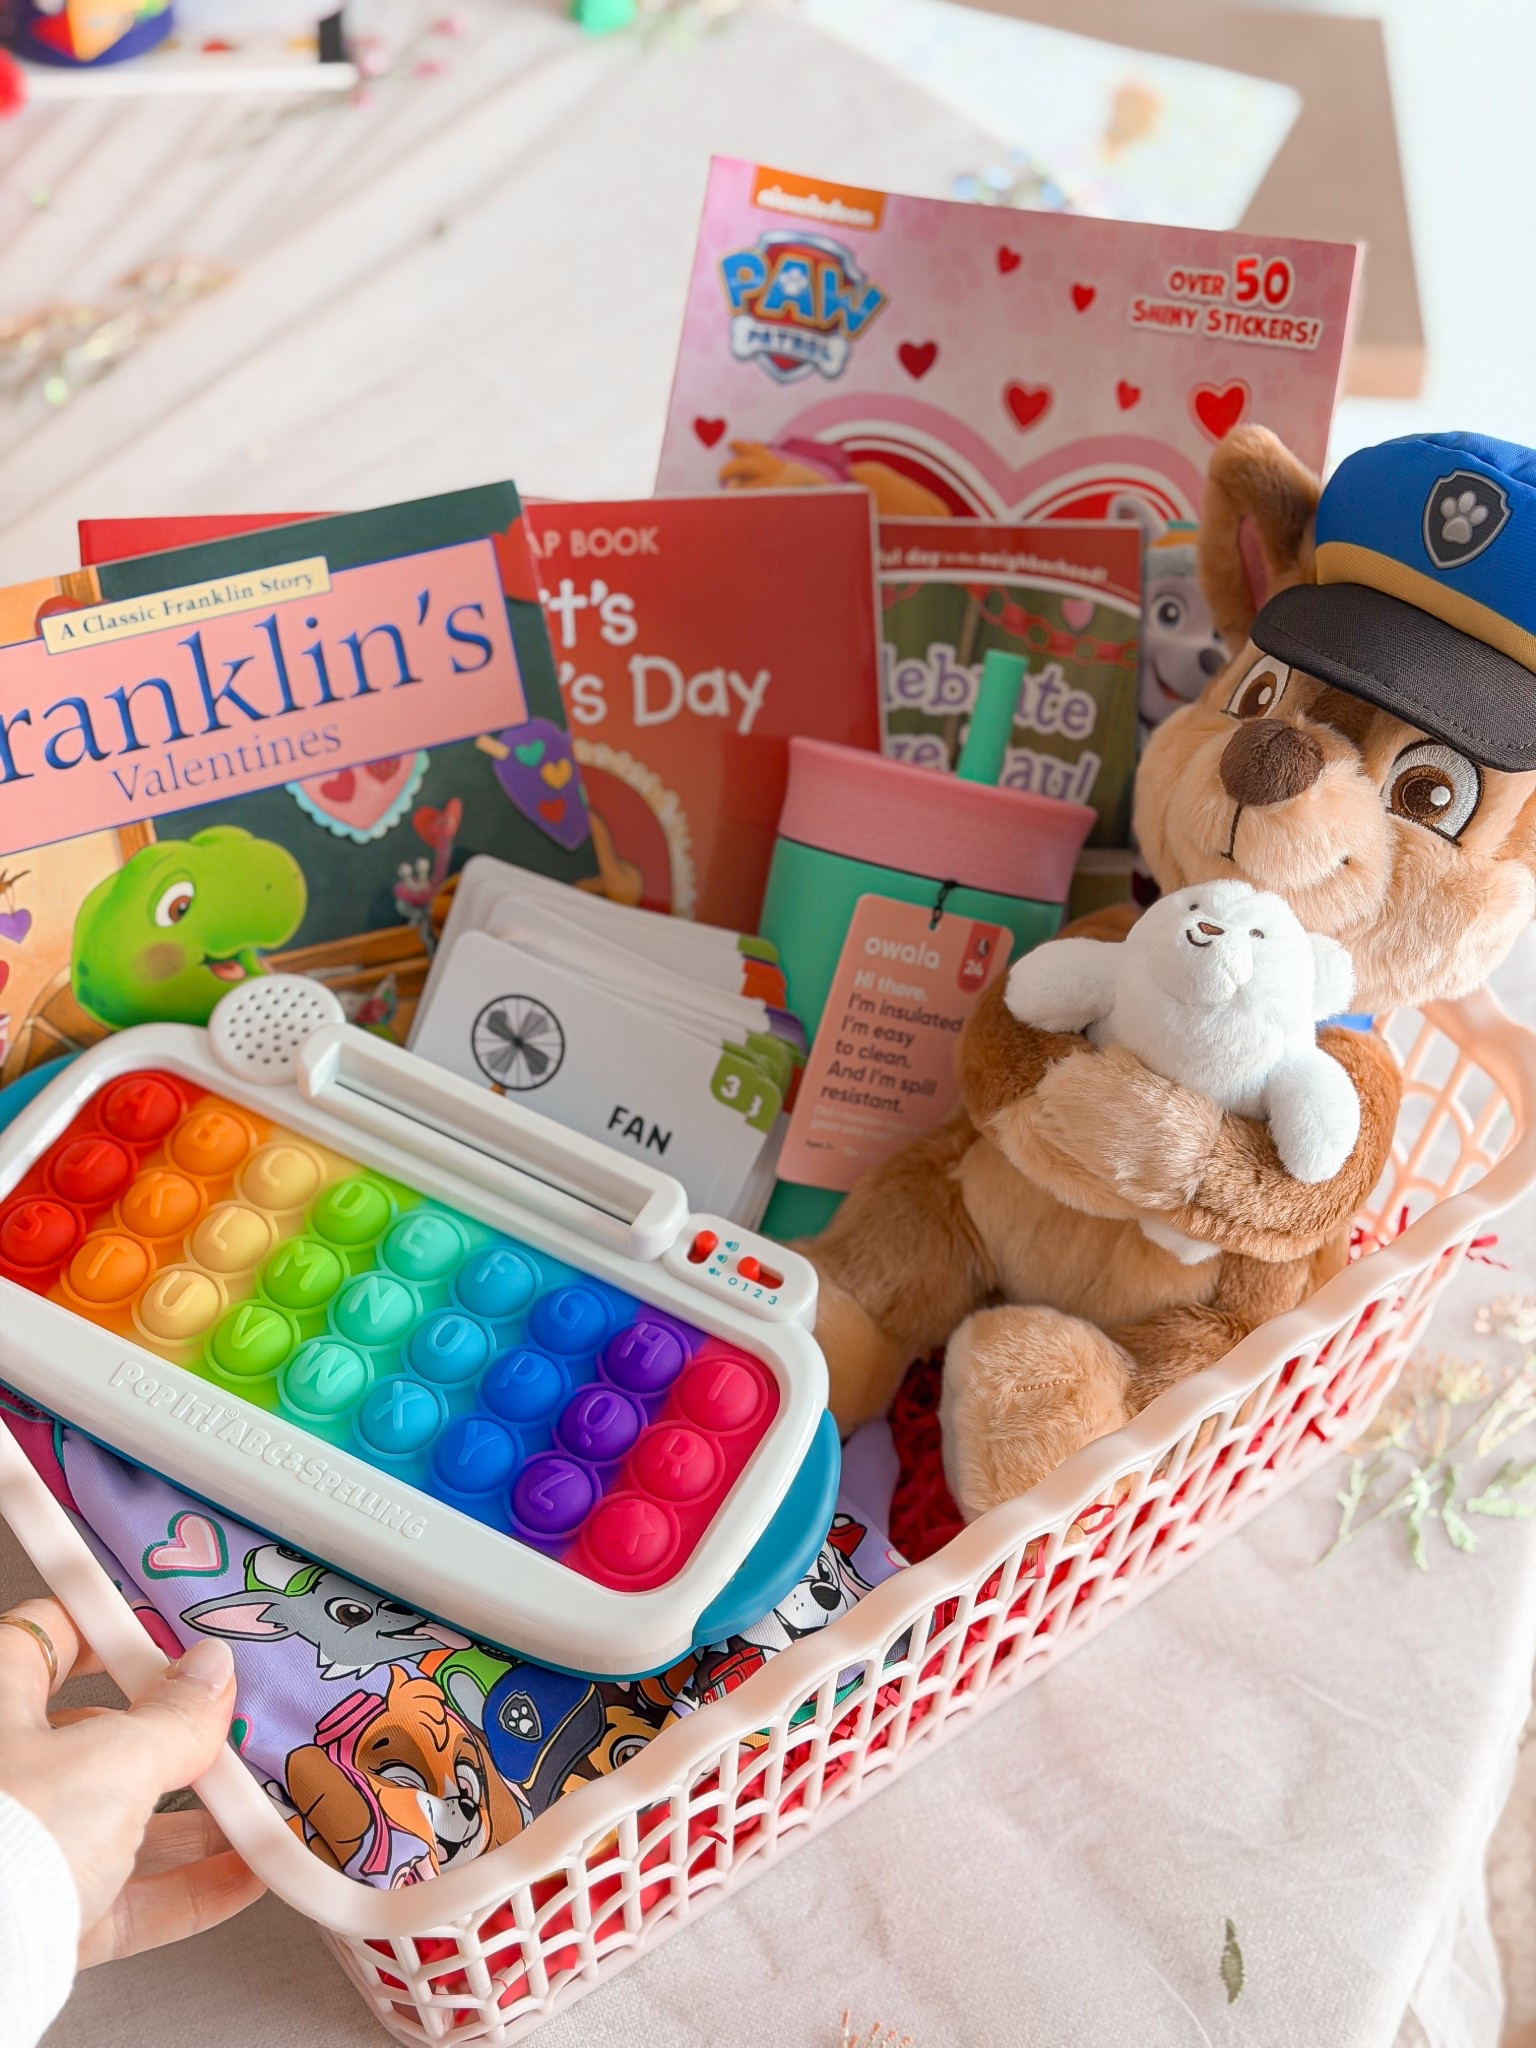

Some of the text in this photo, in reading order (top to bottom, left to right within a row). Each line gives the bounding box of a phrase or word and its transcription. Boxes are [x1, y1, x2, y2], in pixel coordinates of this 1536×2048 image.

[719, 249, 886, 337] PAW
[1170, 258, 1291, 305] OVER 50
[1132, 300, 1319, 345] SHINY STICKERS!
[570, 526, 661, 557] BOOK
[60, 570, 315, 641] A Classic Franklin Story
[628, 653, 771, 736] Day
[111, 722, 342, 802] Valentines
[864, 936, 940, 970] owala
[854, 969, 876, 991] Hi
[841, 1015, 916, 1048] I'm easy
[848, 992, 965, 1033] I'm insulated
[835, 1039, 911, 1069] to clean.
[720, 1074, 741, 1100] 3
[820, 1085, 904, 1114] resistant.
[827, 1061, 937, 1098] And I'm spill
[607, 1105, 673, 1156] FAN
[114, 1081, 738, 1402] A B C D E F G H I
[66, 1143, 699, 1480] J K L M N O P Q R
[742, 1283, 750, 1292] 1
[753, 1288, 763, 1299] 2
[768, 1295, 778, 1305] 3
[11, 1204, 60, 1241] S
[86, 1240, 130, 1281] T
[156, 1269, 198, 1317] U
[230, 1304, 279, 1351] V
[299, 1340, 358, 1397] W
[373, 1380, 425, 1432] X
[457, 1418, 502, 1467] Y
